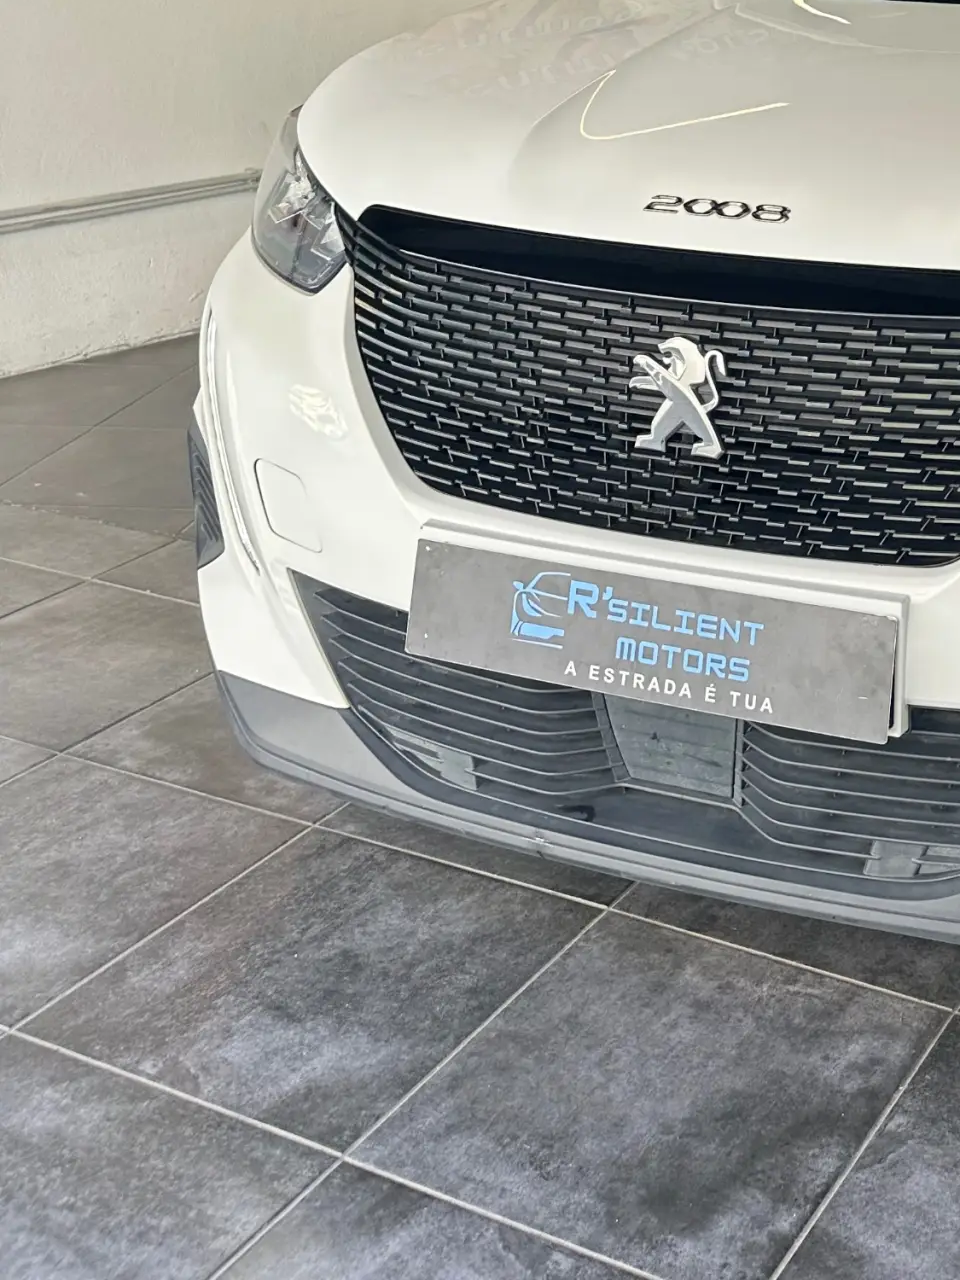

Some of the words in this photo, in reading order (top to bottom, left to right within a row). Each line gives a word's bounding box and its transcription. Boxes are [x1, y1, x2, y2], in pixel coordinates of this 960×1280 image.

[643, 194, 792, 223] 2008
[567, 580, 764, 646] R'SILIENT
[615, 636, 750, 682] MOTORS
[564, 660, 577, 676] A
[588, 664, 692, 699] ESTRADA
[704, 683, 717, 704] É
[730, 691, 773, 714] TUA
